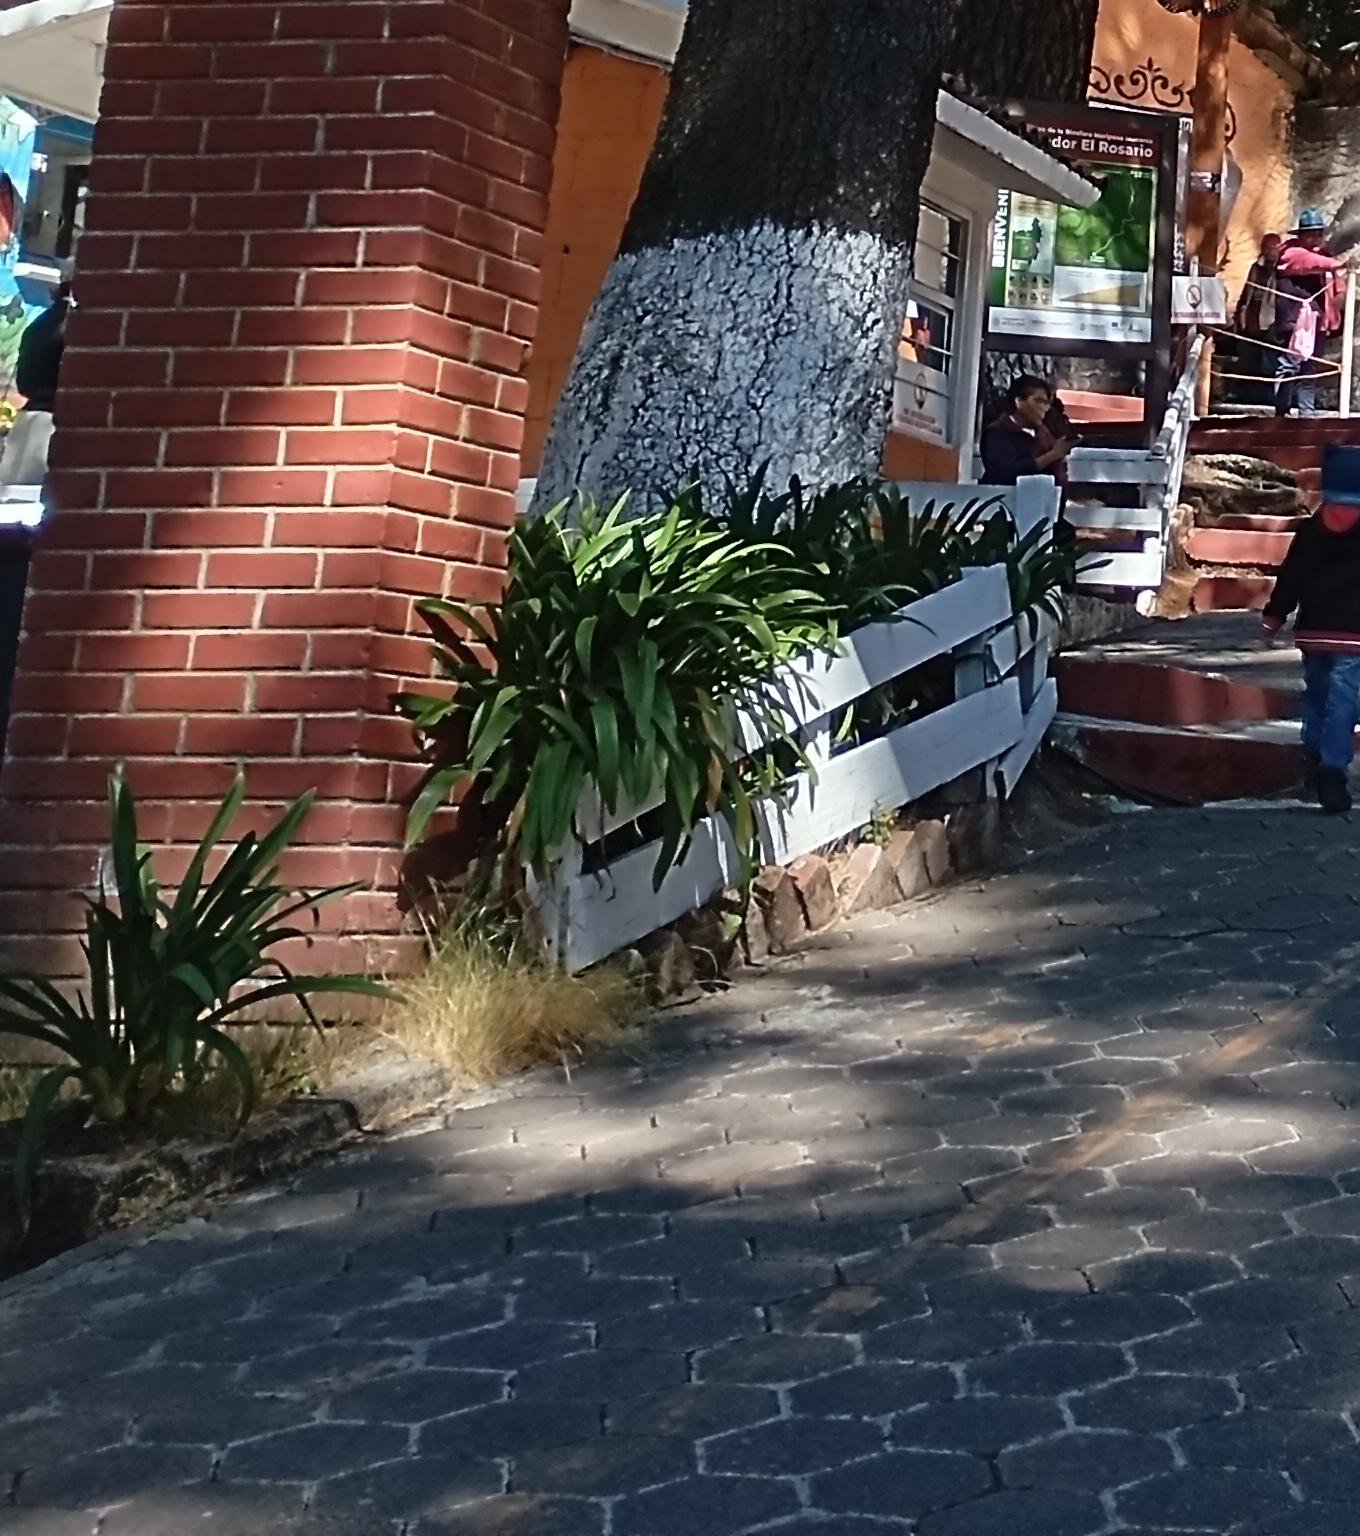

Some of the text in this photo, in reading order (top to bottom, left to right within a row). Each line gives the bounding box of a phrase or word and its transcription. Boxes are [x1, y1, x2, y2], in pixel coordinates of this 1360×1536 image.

[1049, 135, 1154, 158] dor El Rosario
